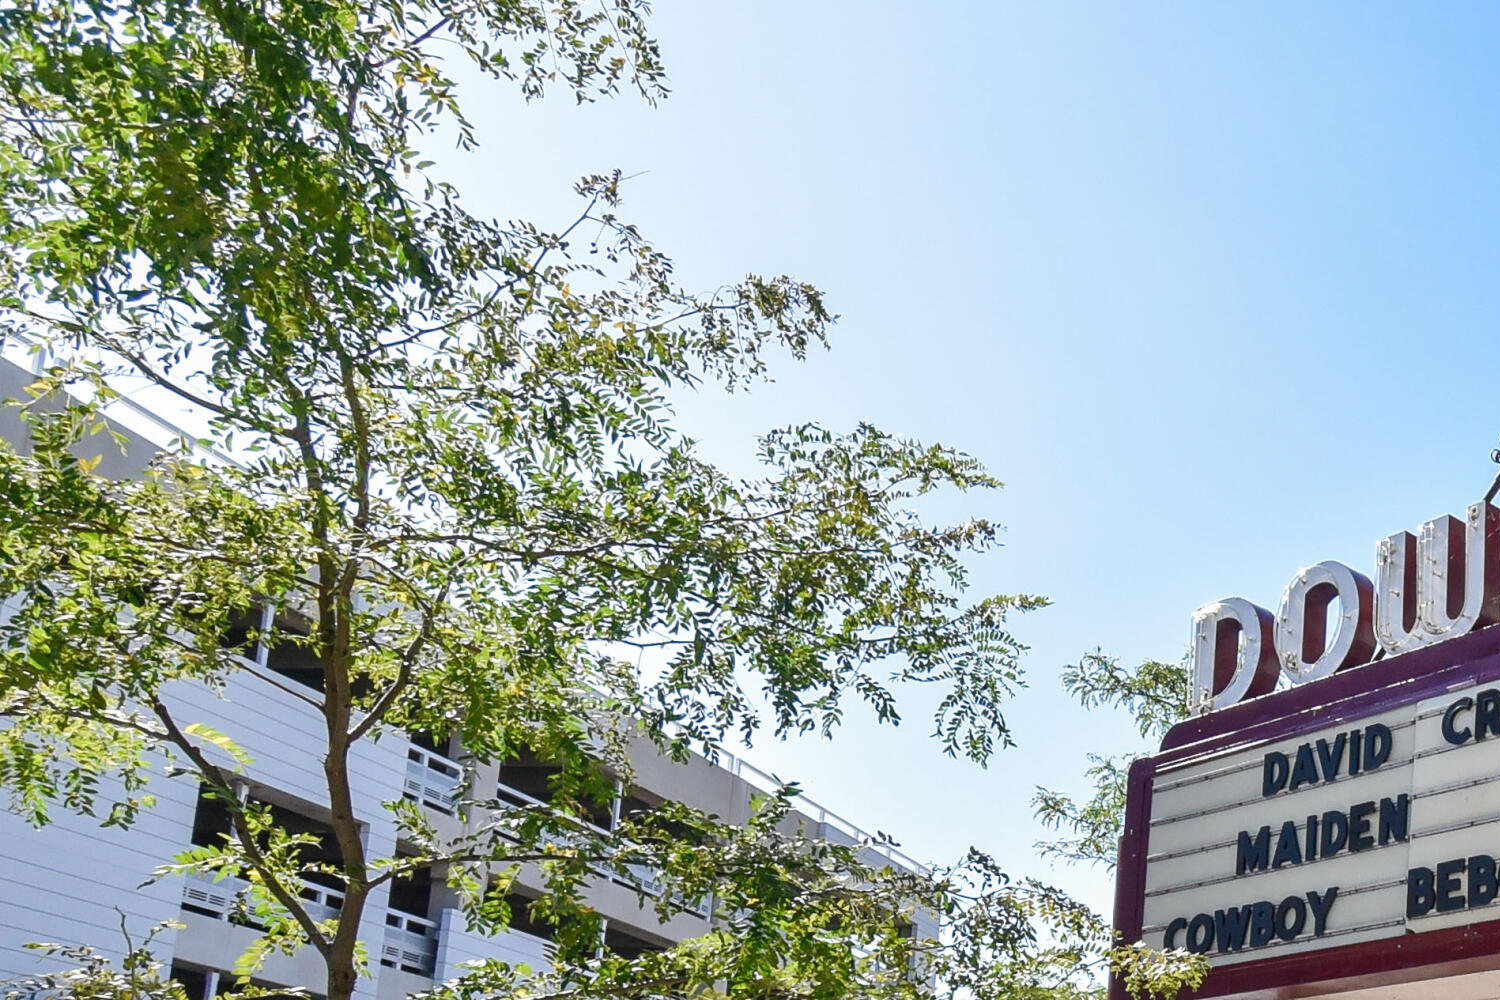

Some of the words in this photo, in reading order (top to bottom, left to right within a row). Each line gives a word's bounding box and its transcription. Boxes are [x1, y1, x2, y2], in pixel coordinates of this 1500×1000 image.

[1262, 723, 1393, 798] DAVID
[1235, 793, 1410, 876] MAIDEN
[1163, 886, 1339, 955] COWBOY
